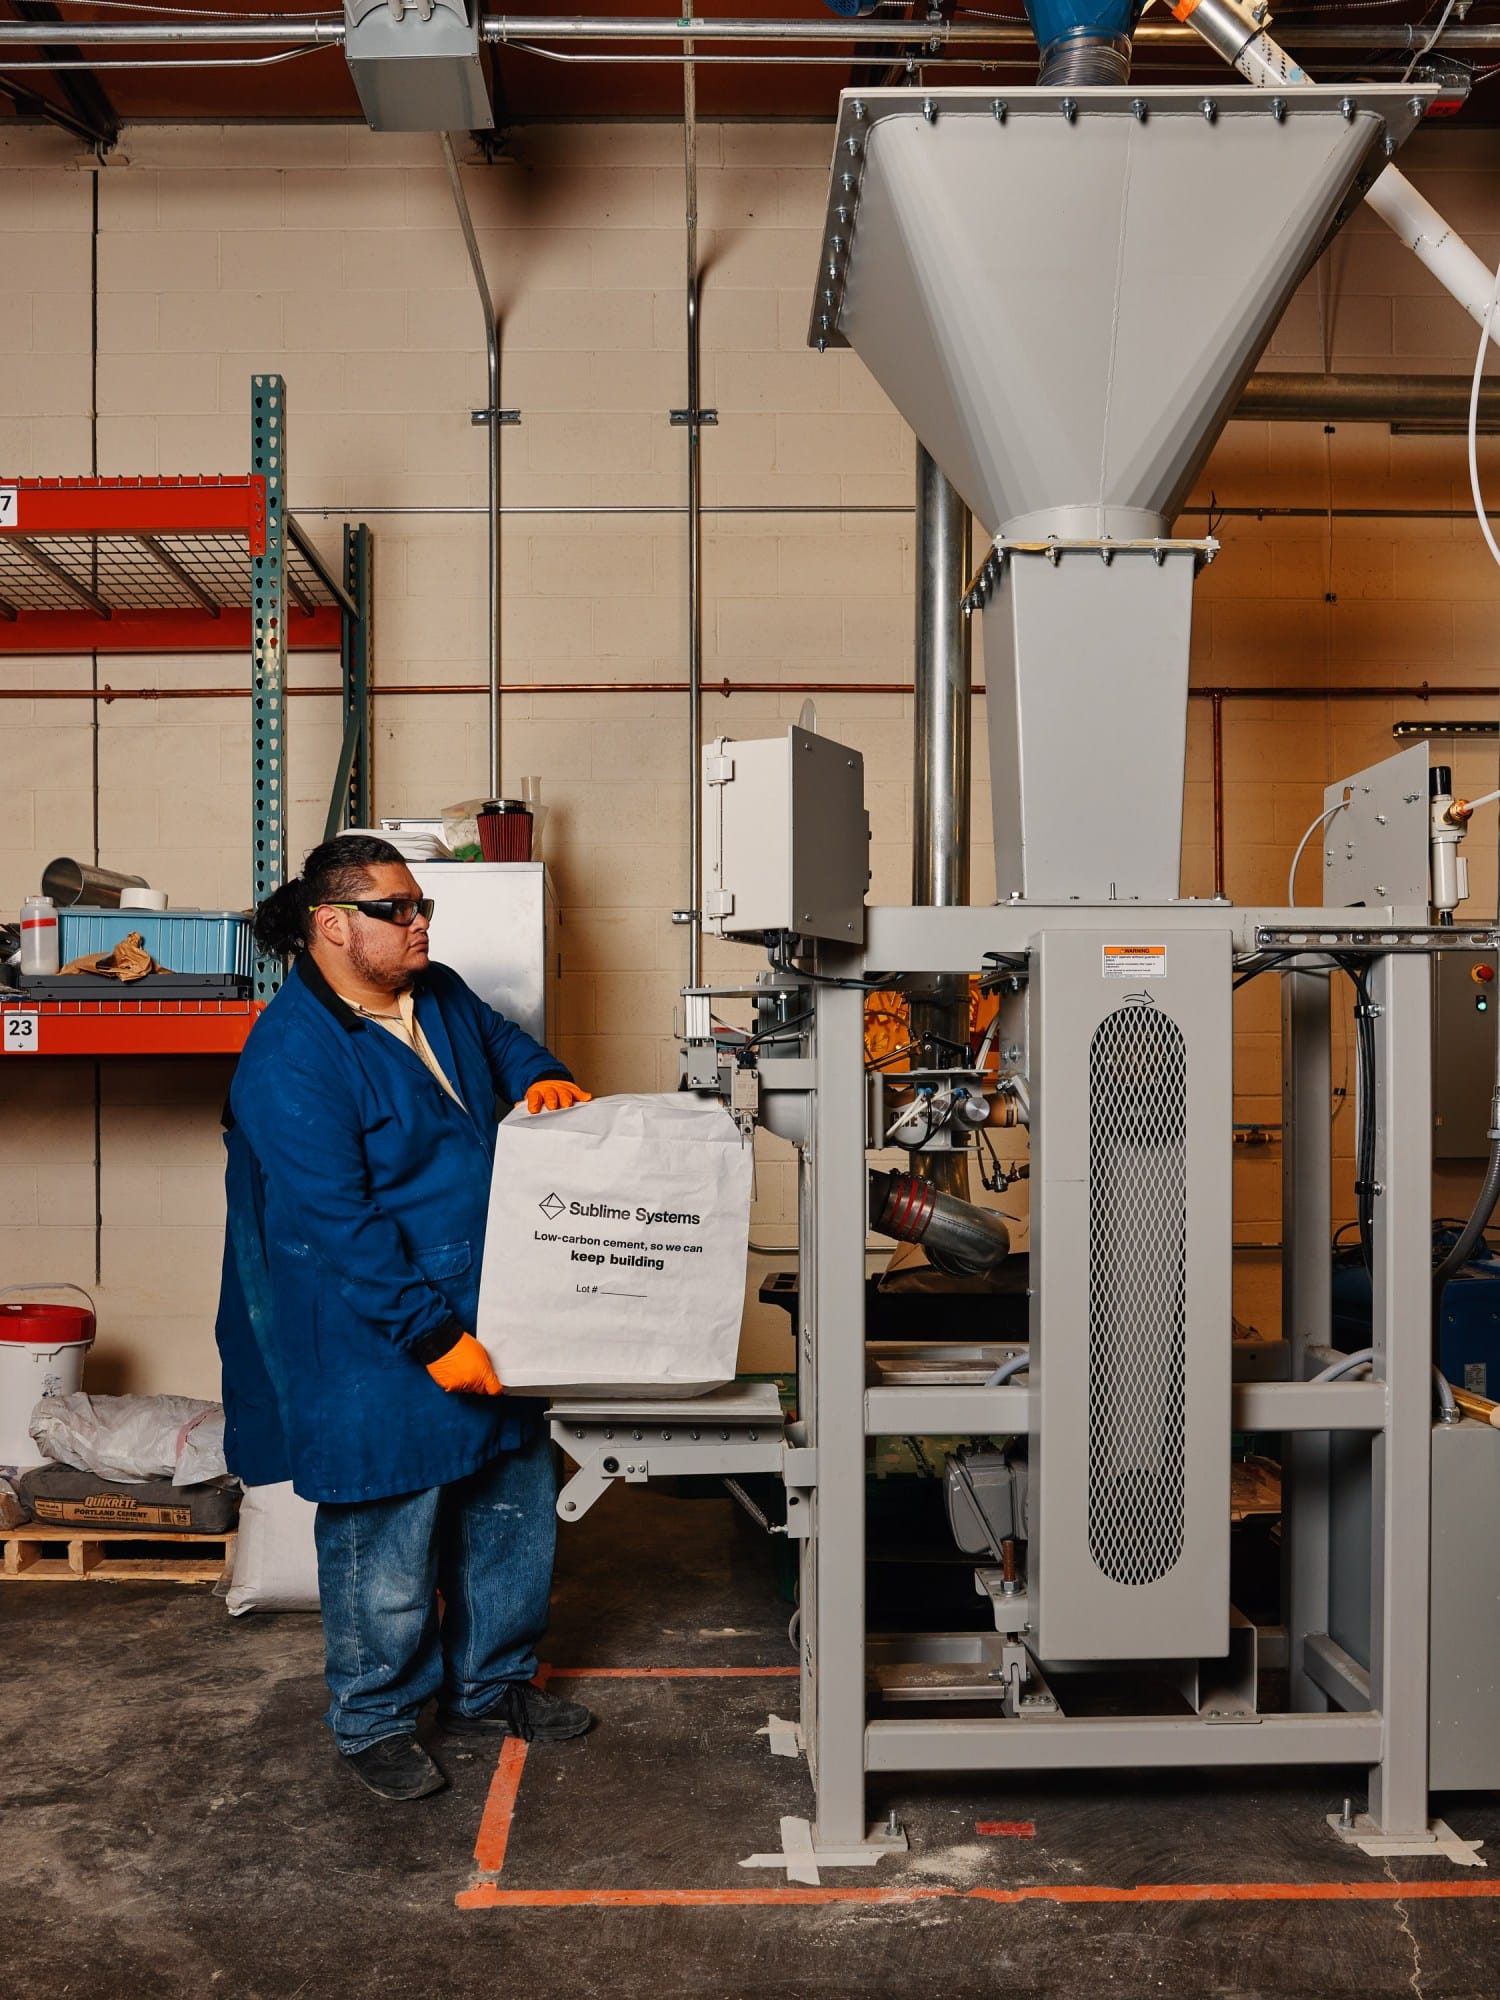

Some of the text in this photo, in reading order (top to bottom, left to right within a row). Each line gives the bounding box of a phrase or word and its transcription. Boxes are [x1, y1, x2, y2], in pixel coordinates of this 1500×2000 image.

[9, 1019, 33, 1036] 23
[569, 1201, 701, 1225] Sublime Systems
[534, 1230, 703, 1253] Low-carbon cement, so we can
[570, 1250, 665, 1271] keep building
[576, 1284, 598, 1293] Lot #
[84, 1496, 137, 1509] QUIKRETE
[74, 1508, 115, 1517] PORTLAND
[117, 1509, 148, 1518] CEMENT
